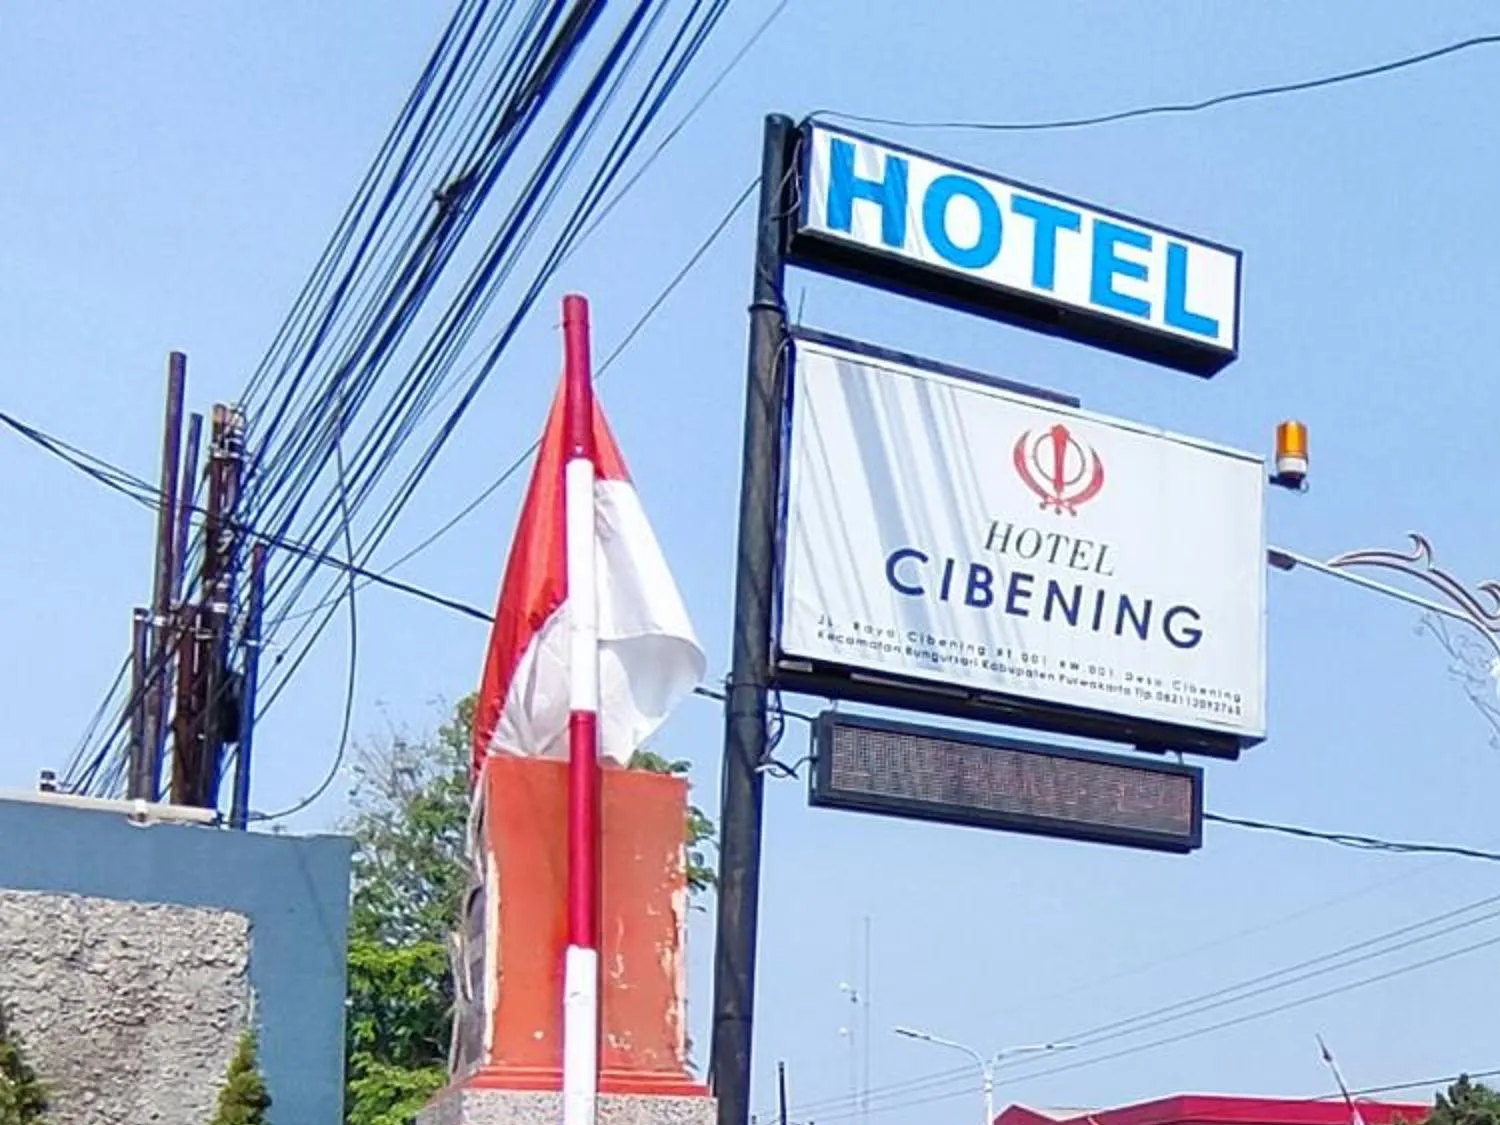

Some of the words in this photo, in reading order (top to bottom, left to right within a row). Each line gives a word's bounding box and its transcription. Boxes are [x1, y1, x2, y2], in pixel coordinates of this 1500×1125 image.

[827, 136, 1219, 339] HOTEL
[886, 547, 1203, 648] CIBENING
[984, 519, 1115, 577] HOTEL
